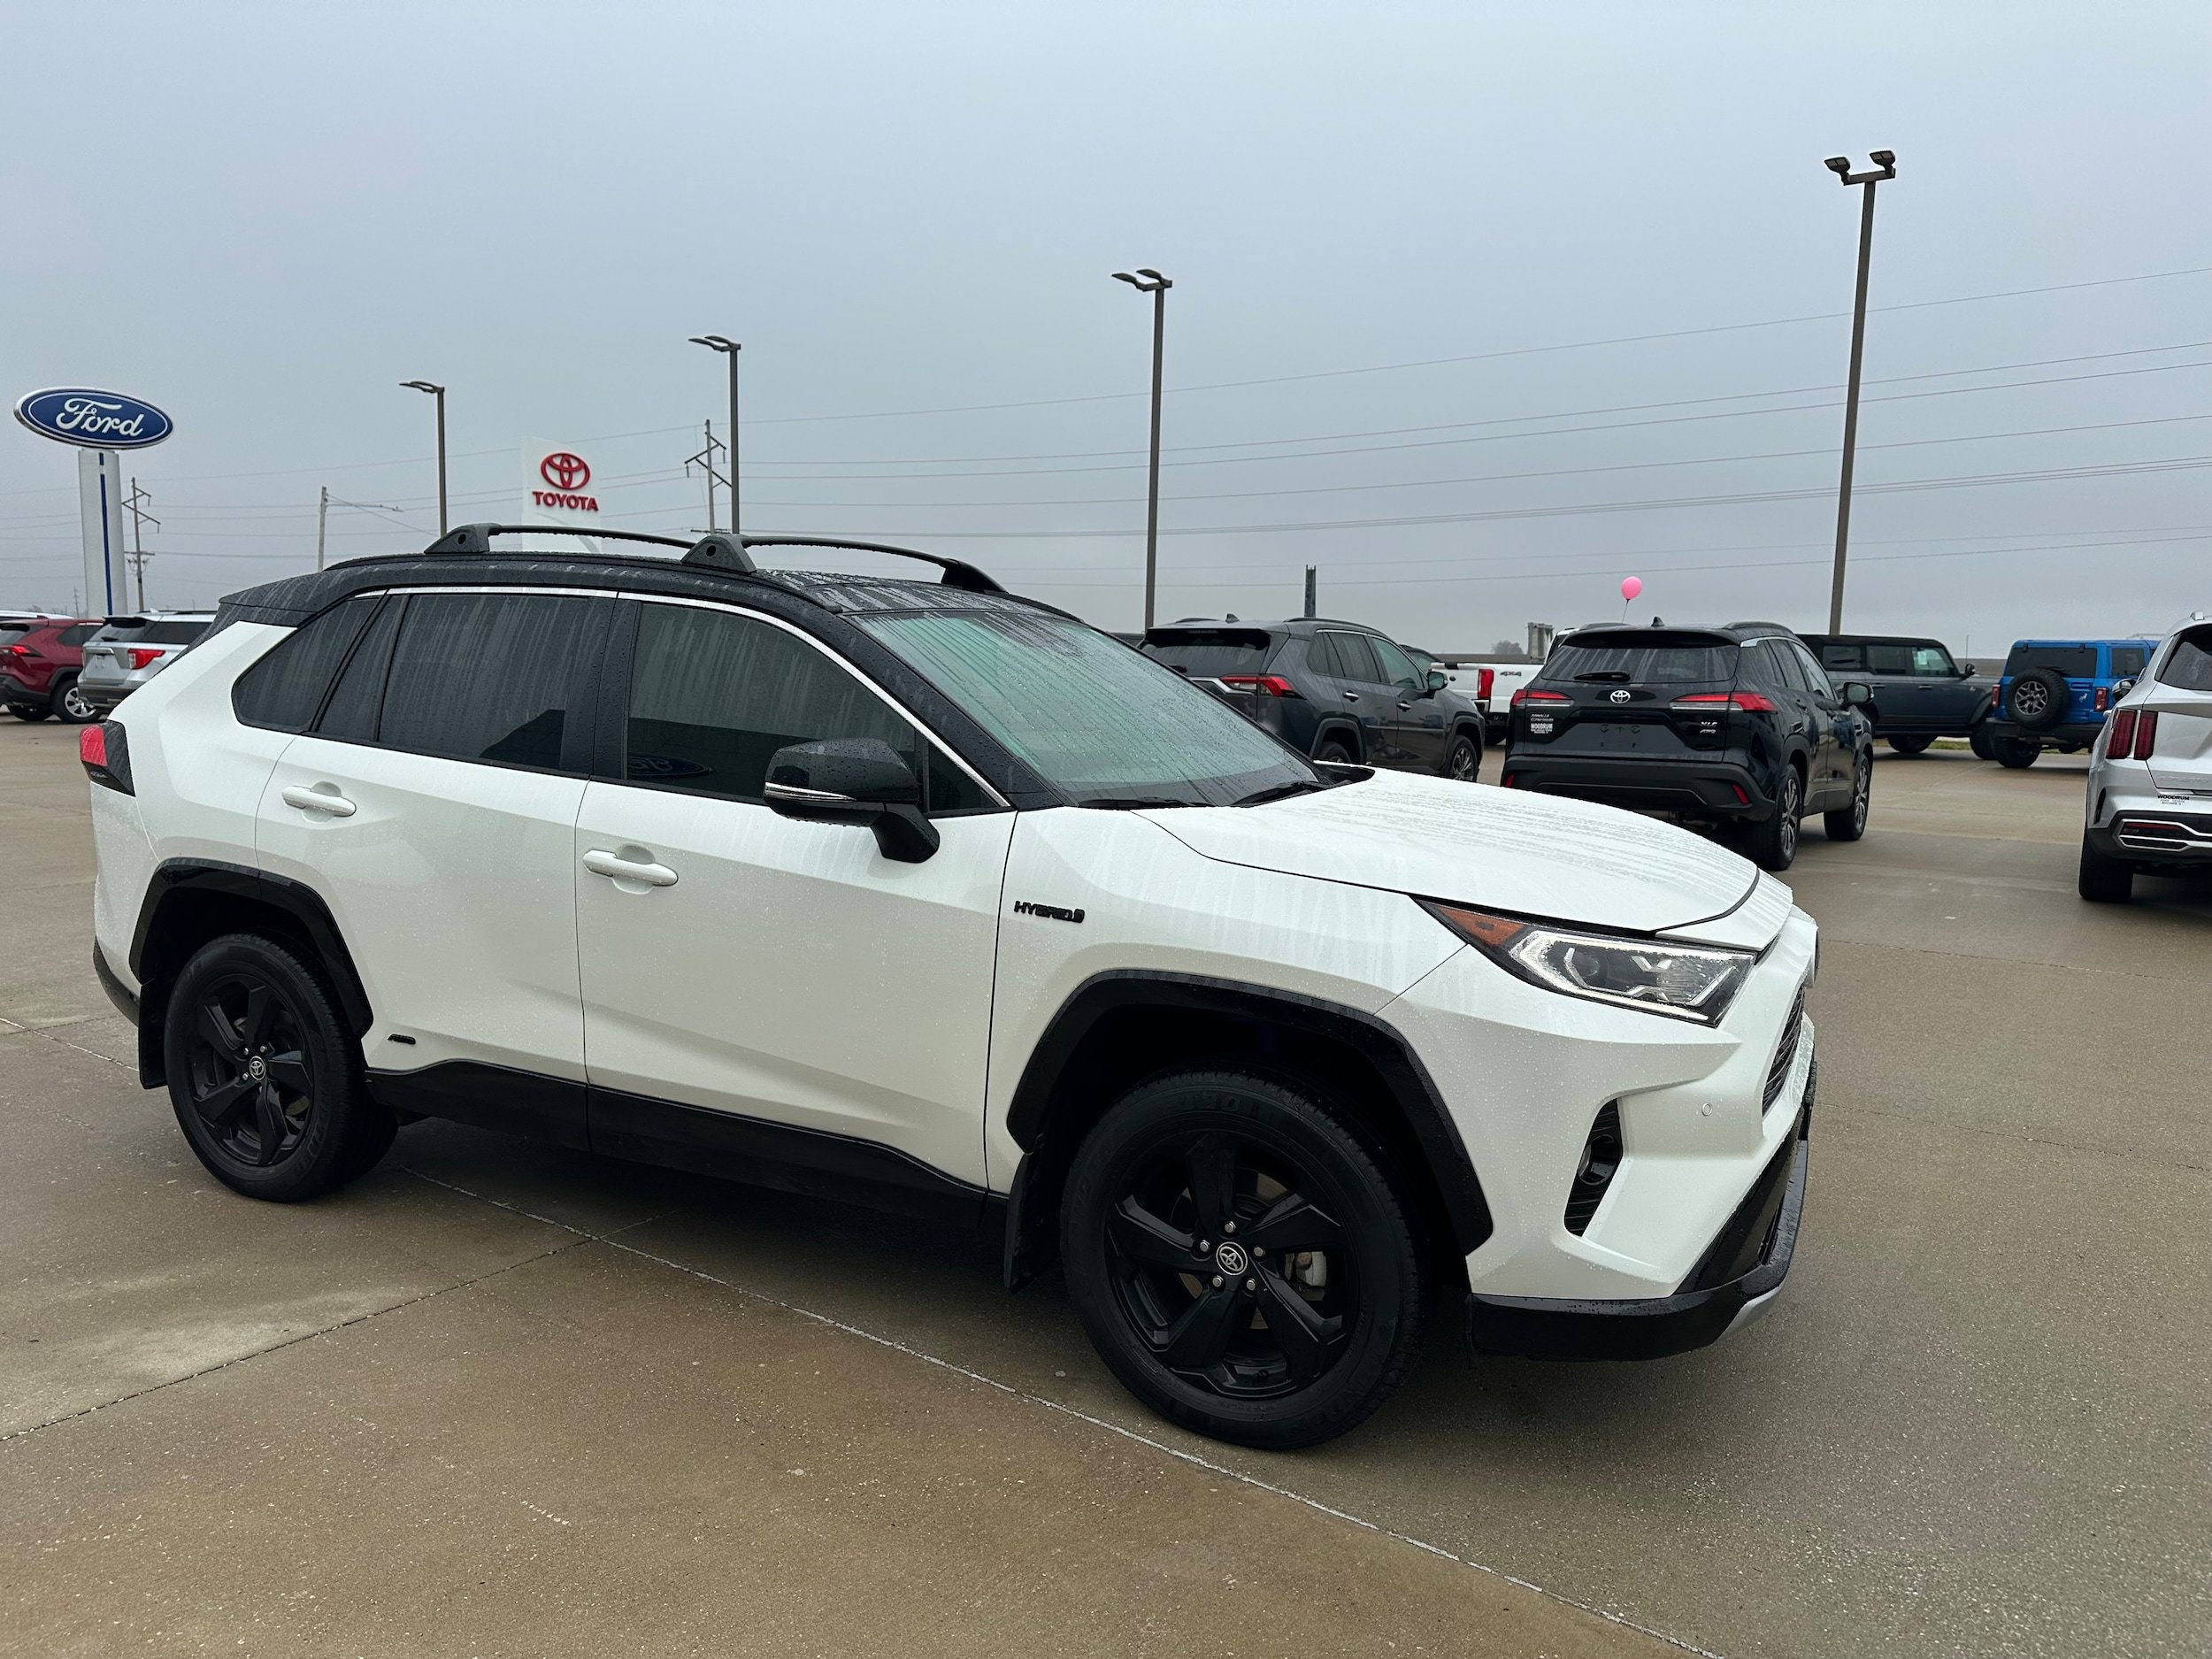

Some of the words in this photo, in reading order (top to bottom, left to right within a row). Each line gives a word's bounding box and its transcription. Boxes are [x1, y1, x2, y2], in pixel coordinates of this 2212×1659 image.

[56, 397, 144, 437] Ford
[532, 490, 599, 512] TOYOTA
[1014, 900, 1072, 920] HYBRID
